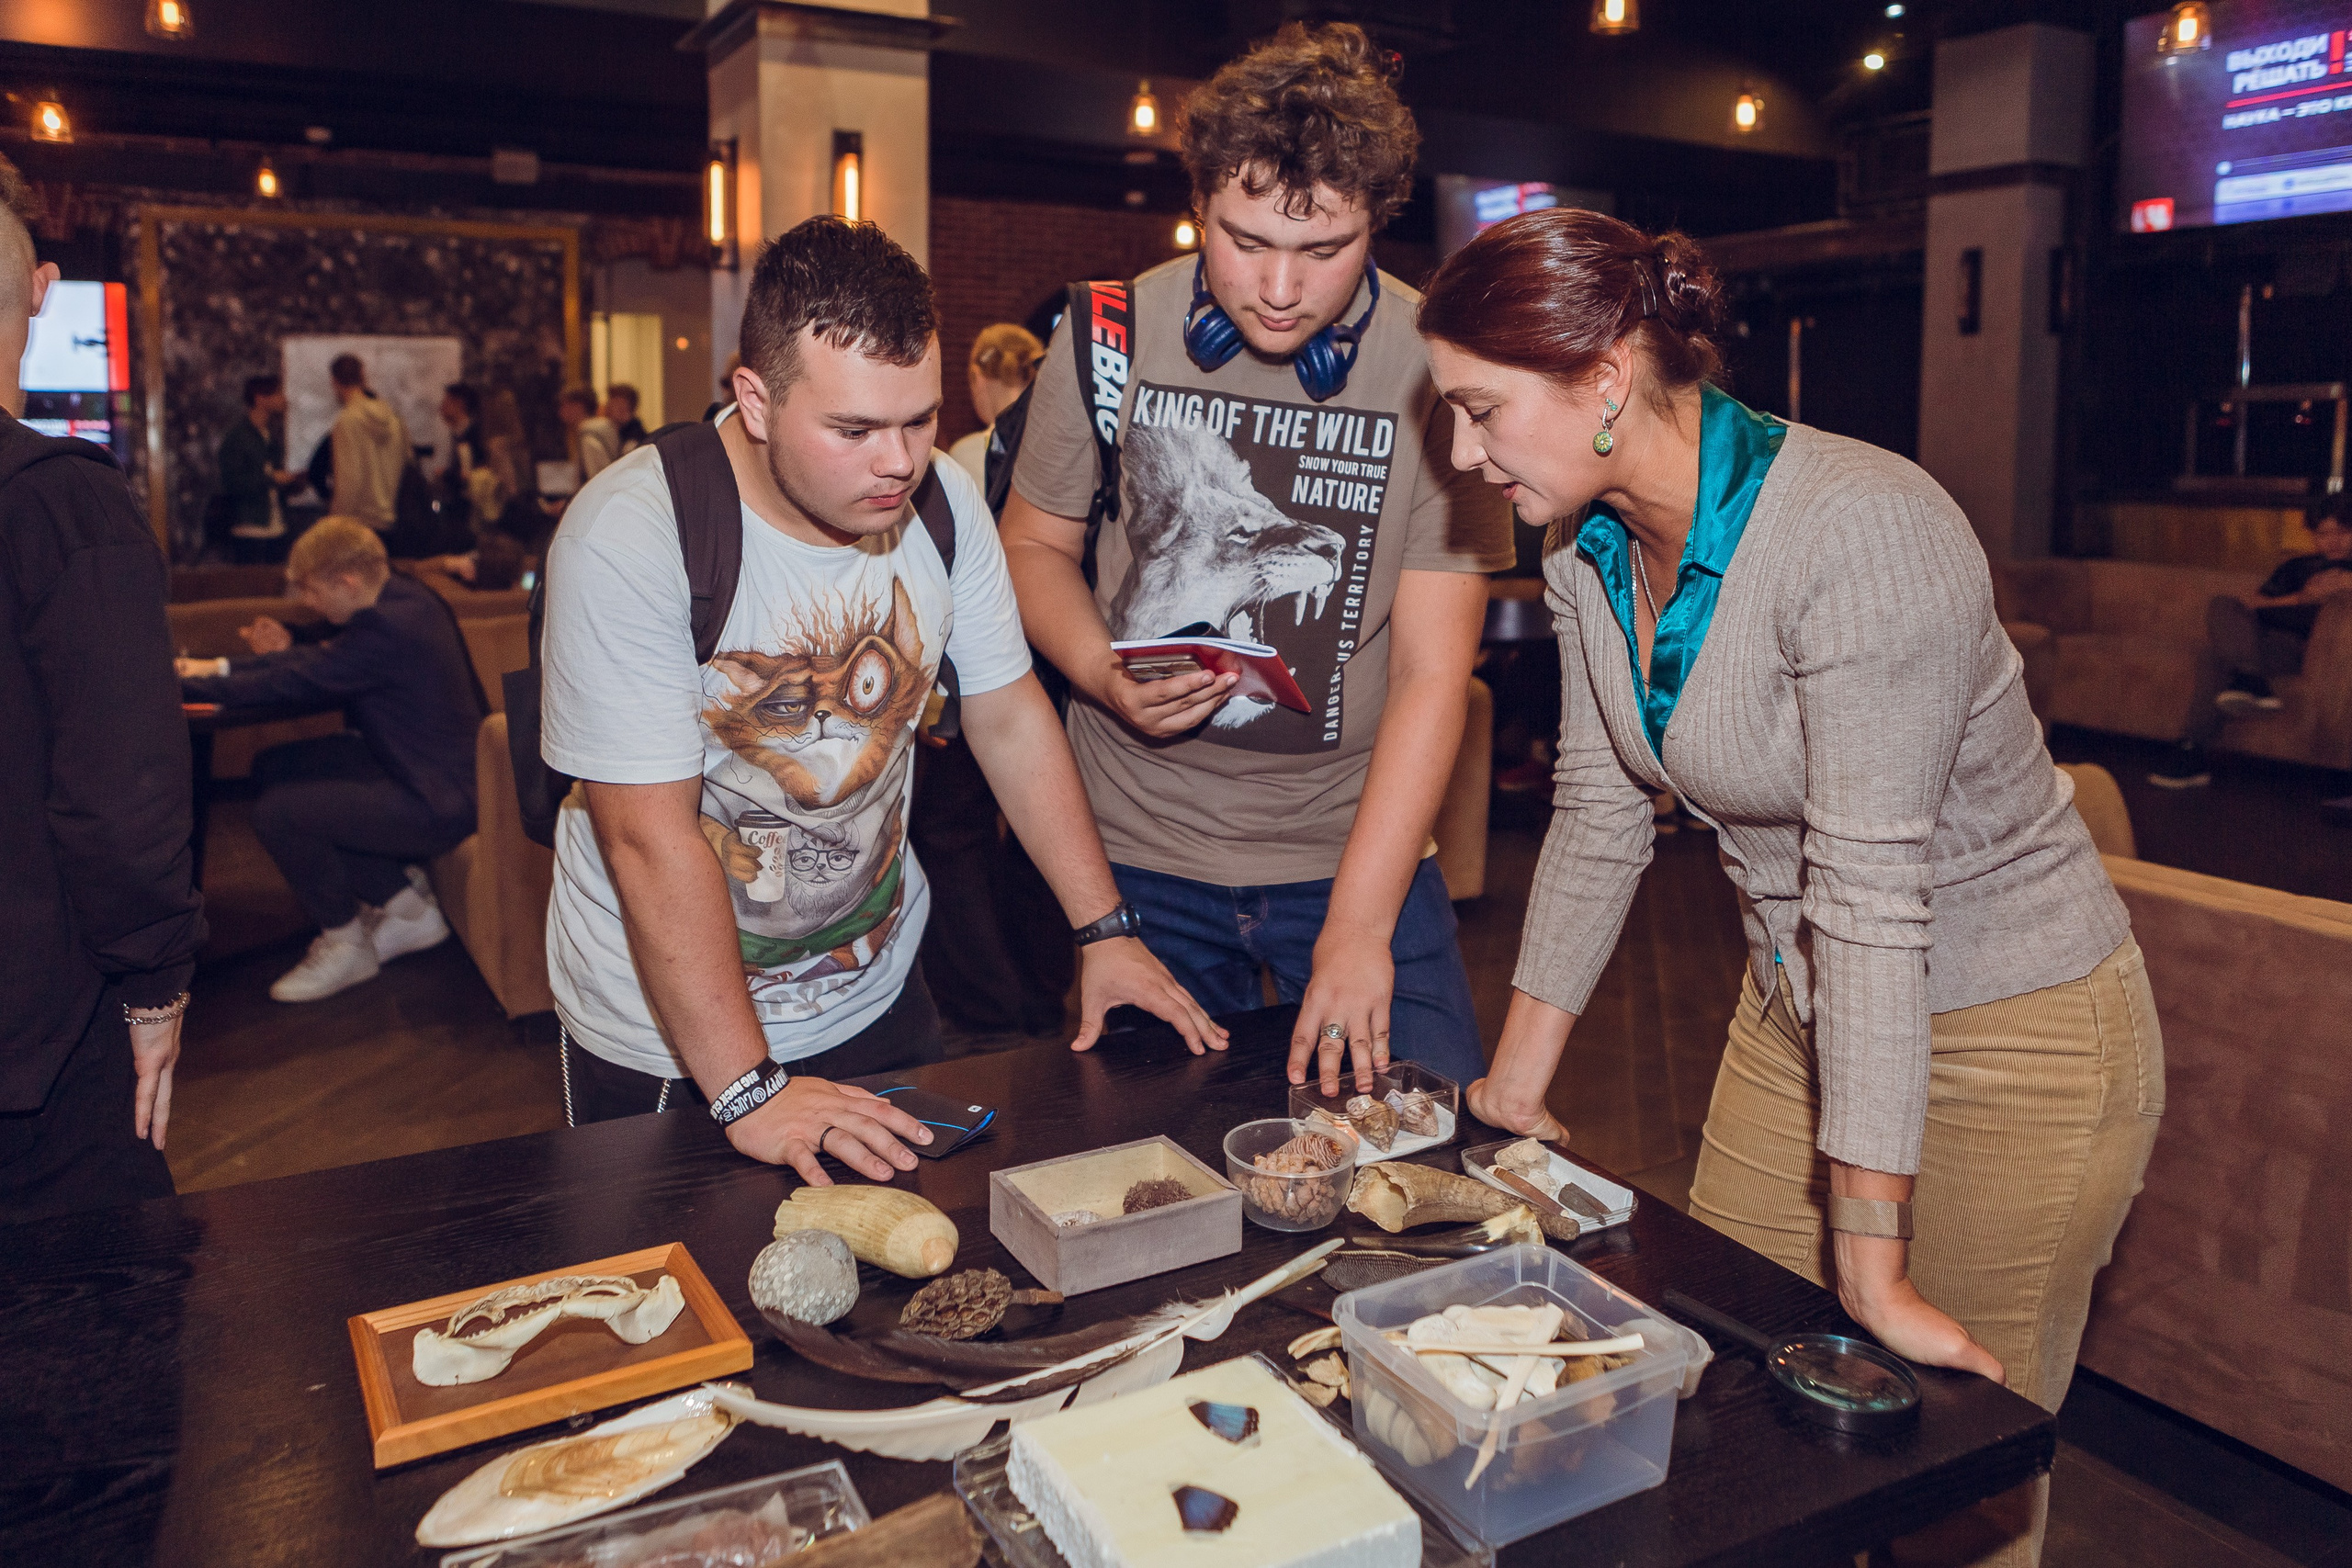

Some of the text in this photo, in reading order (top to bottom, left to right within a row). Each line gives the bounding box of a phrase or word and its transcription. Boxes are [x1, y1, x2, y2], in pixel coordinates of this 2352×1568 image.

[1133, 386, 1394, 458] KING OF THE WILD
[1298, 455, 1387, 479] SNOW YOUR TRUE
[1292, 474, 1384, 513] NATURE
[1324, 525, 1374, 741] DANGERUS TERRITORY
[718, 1080, 745, 1106] DICK
[740, 1069, 761, 1088] BIG
